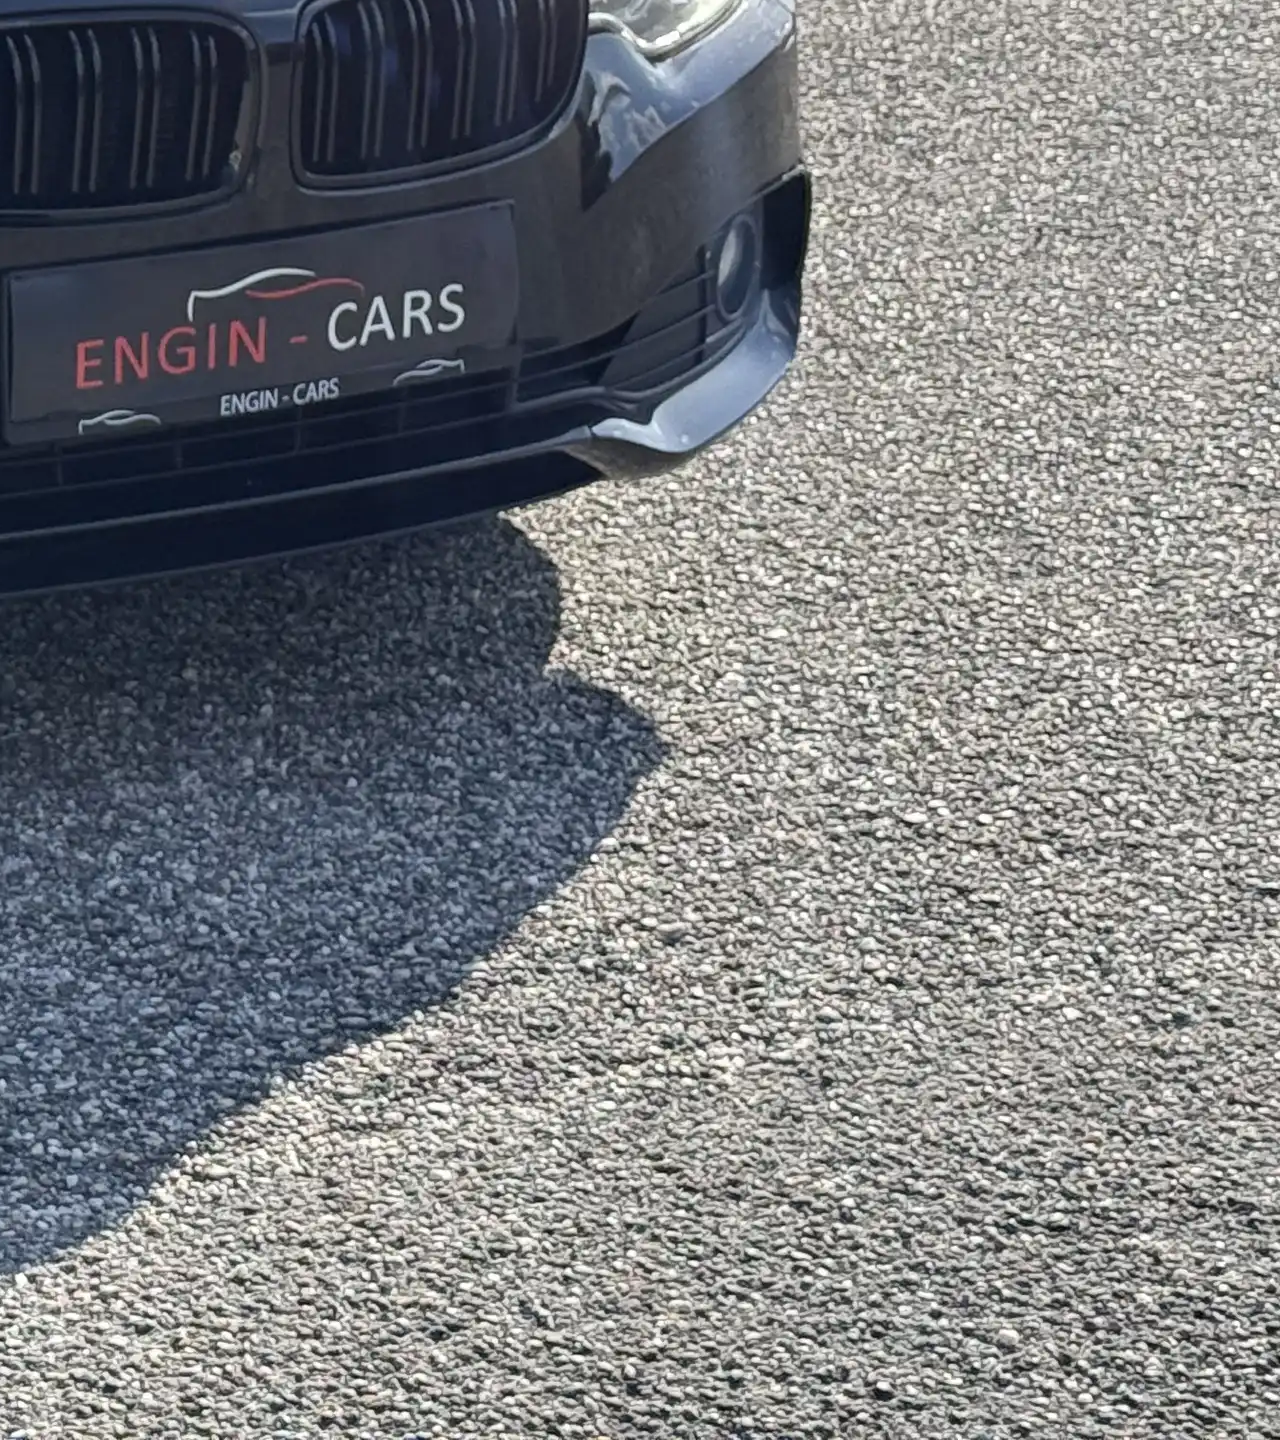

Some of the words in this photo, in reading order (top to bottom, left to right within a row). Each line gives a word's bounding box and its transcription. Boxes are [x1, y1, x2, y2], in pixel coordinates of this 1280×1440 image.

[74, 316, 268, 390] ENGIN
[327, 283, 466, 352] CARS
[219, 387, 279, 417] ENGIN
[292, 377, 340, 408] CARS
